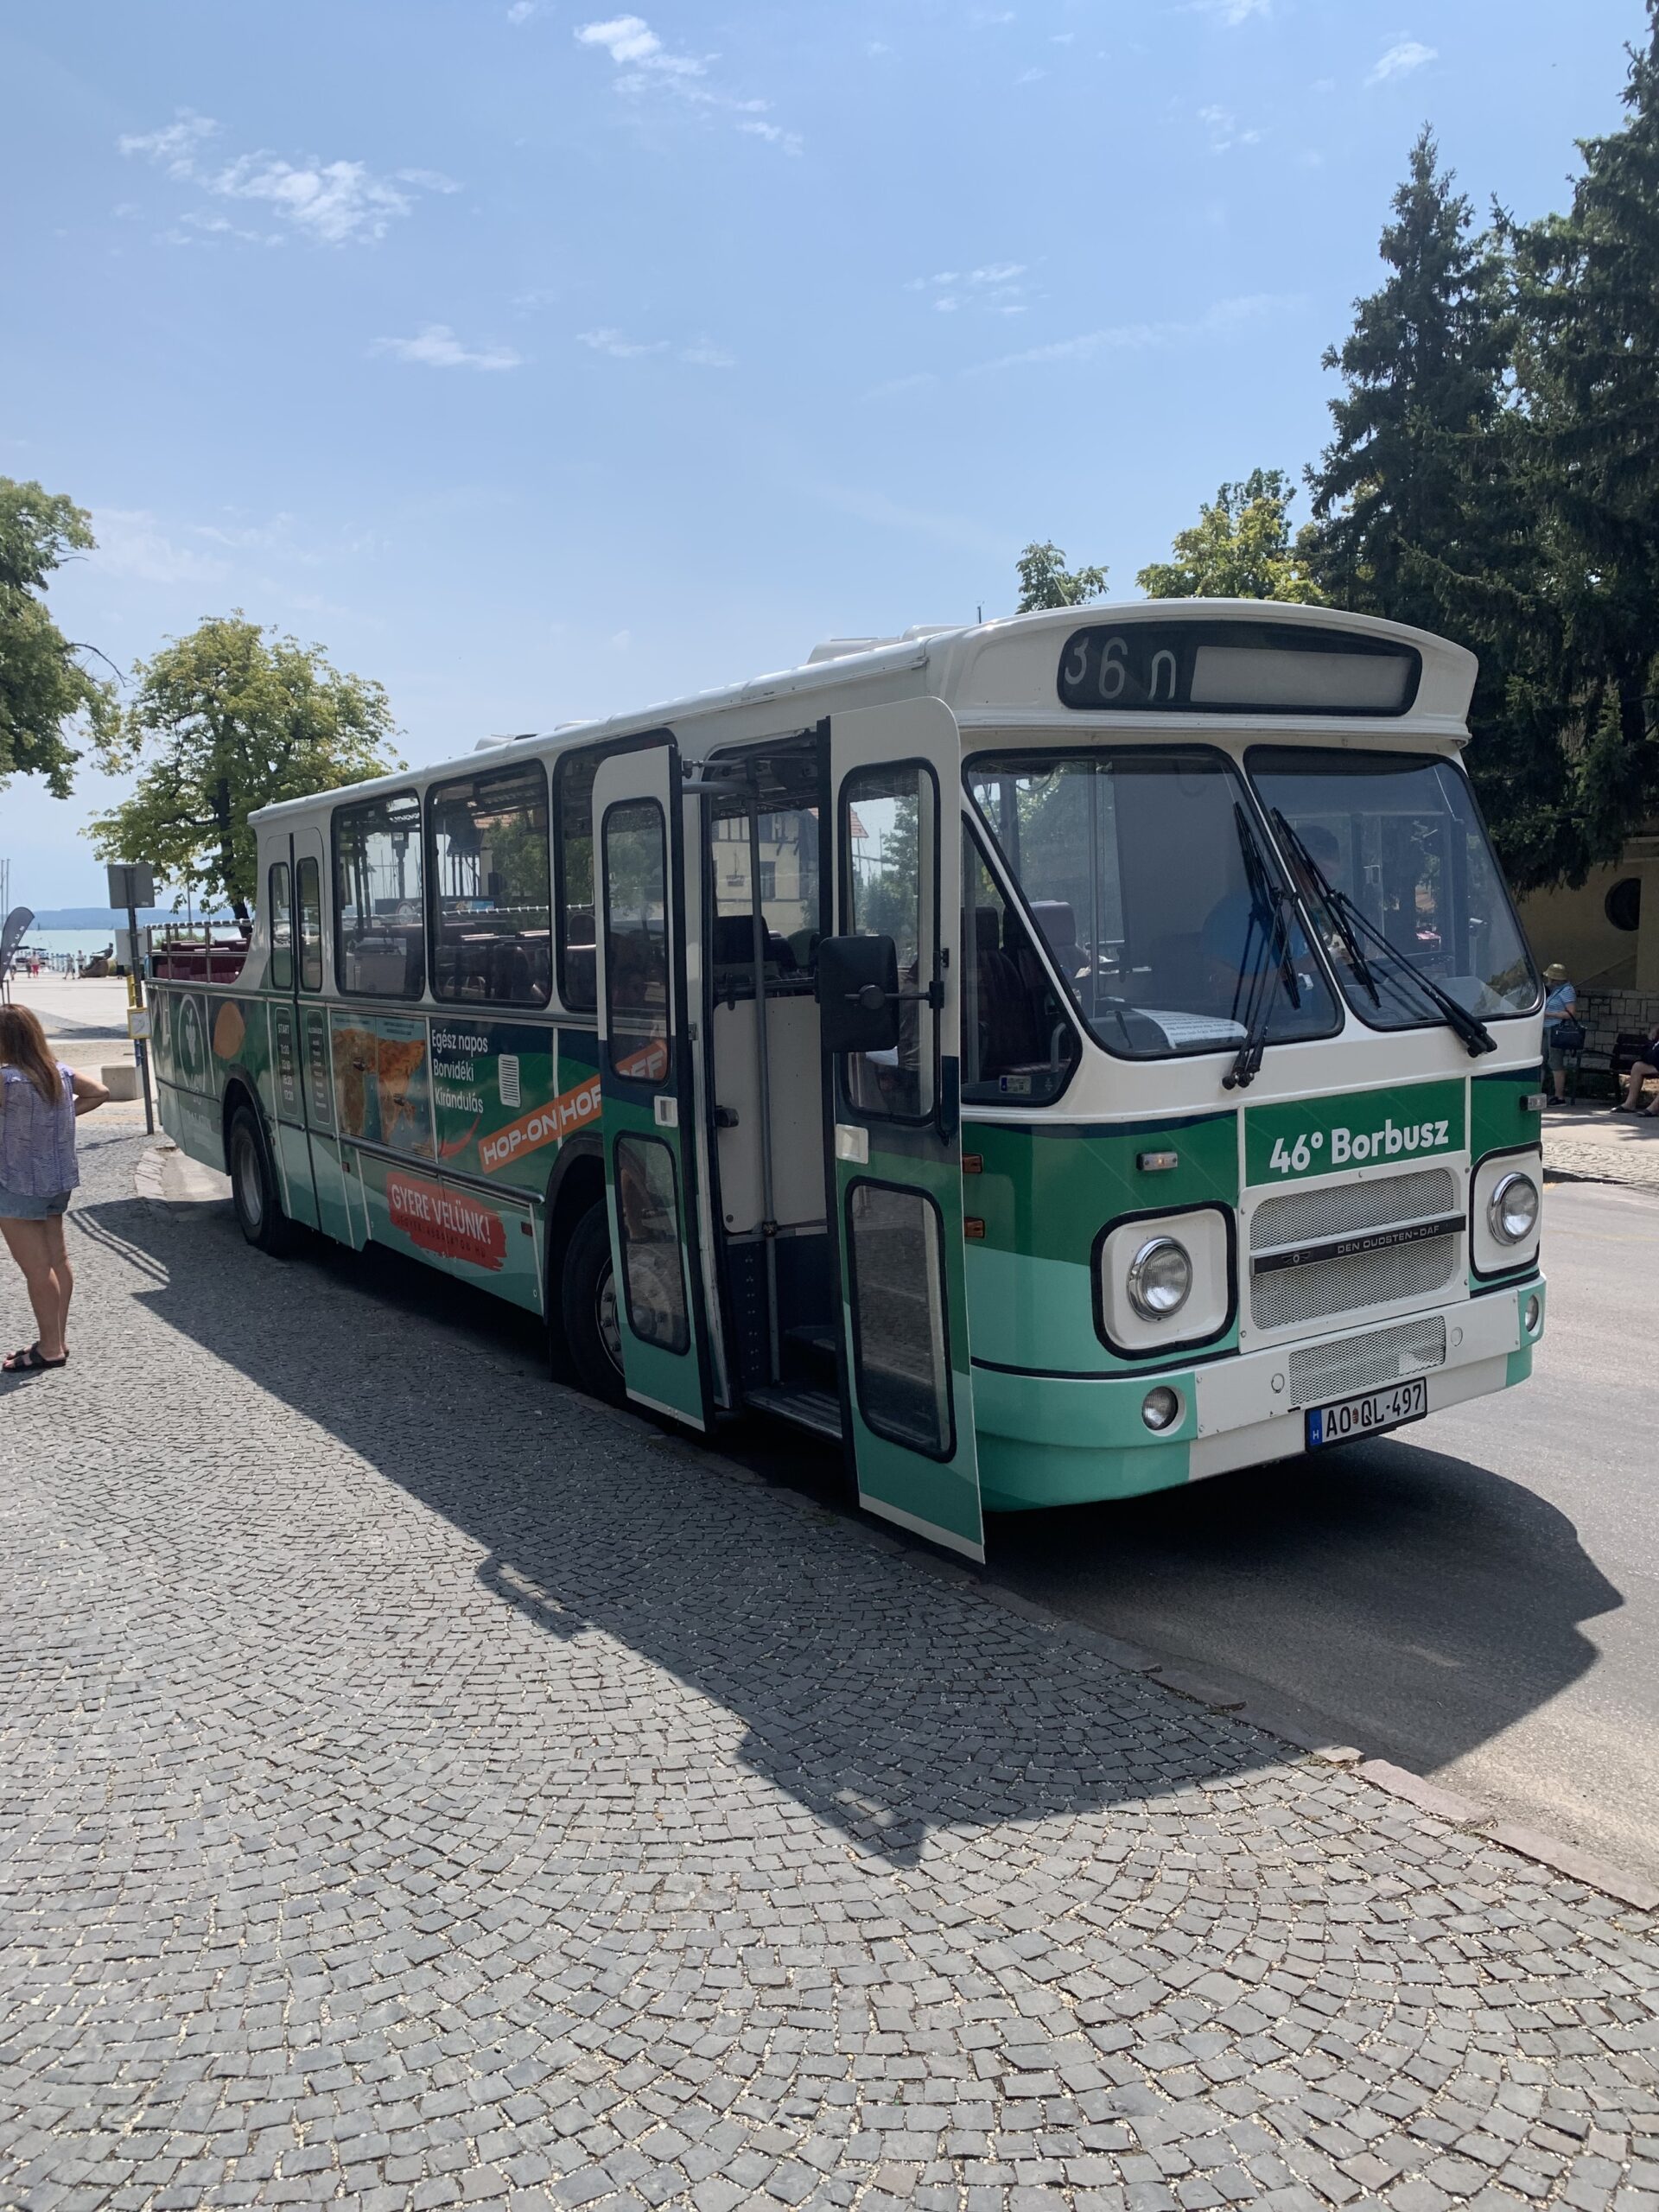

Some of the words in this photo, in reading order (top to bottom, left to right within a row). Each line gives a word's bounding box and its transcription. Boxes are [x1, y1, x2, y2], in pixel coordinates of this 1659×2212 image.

[432, 1028, 457, 1053] Egész
[458, 1034, 488, 1058] napos
[433, 1058, 474, 1082] Borvidéki
[435, 1087, 484, 1114] Kirándulás
[483, 1107, 558, 1165] HOP-ON
[1332, 1119, 1449, 1164] Borbusz
[391, 1184, 431, 1221] GYERE
[432, 1198, 492, 1244] VELÜNK!
[1338, 1242, 1360, 1253] DEN
[1363, 1225, 1440, 1249] OUDSTEN-DAF
[1313, 1429, 1319, 1440] H
